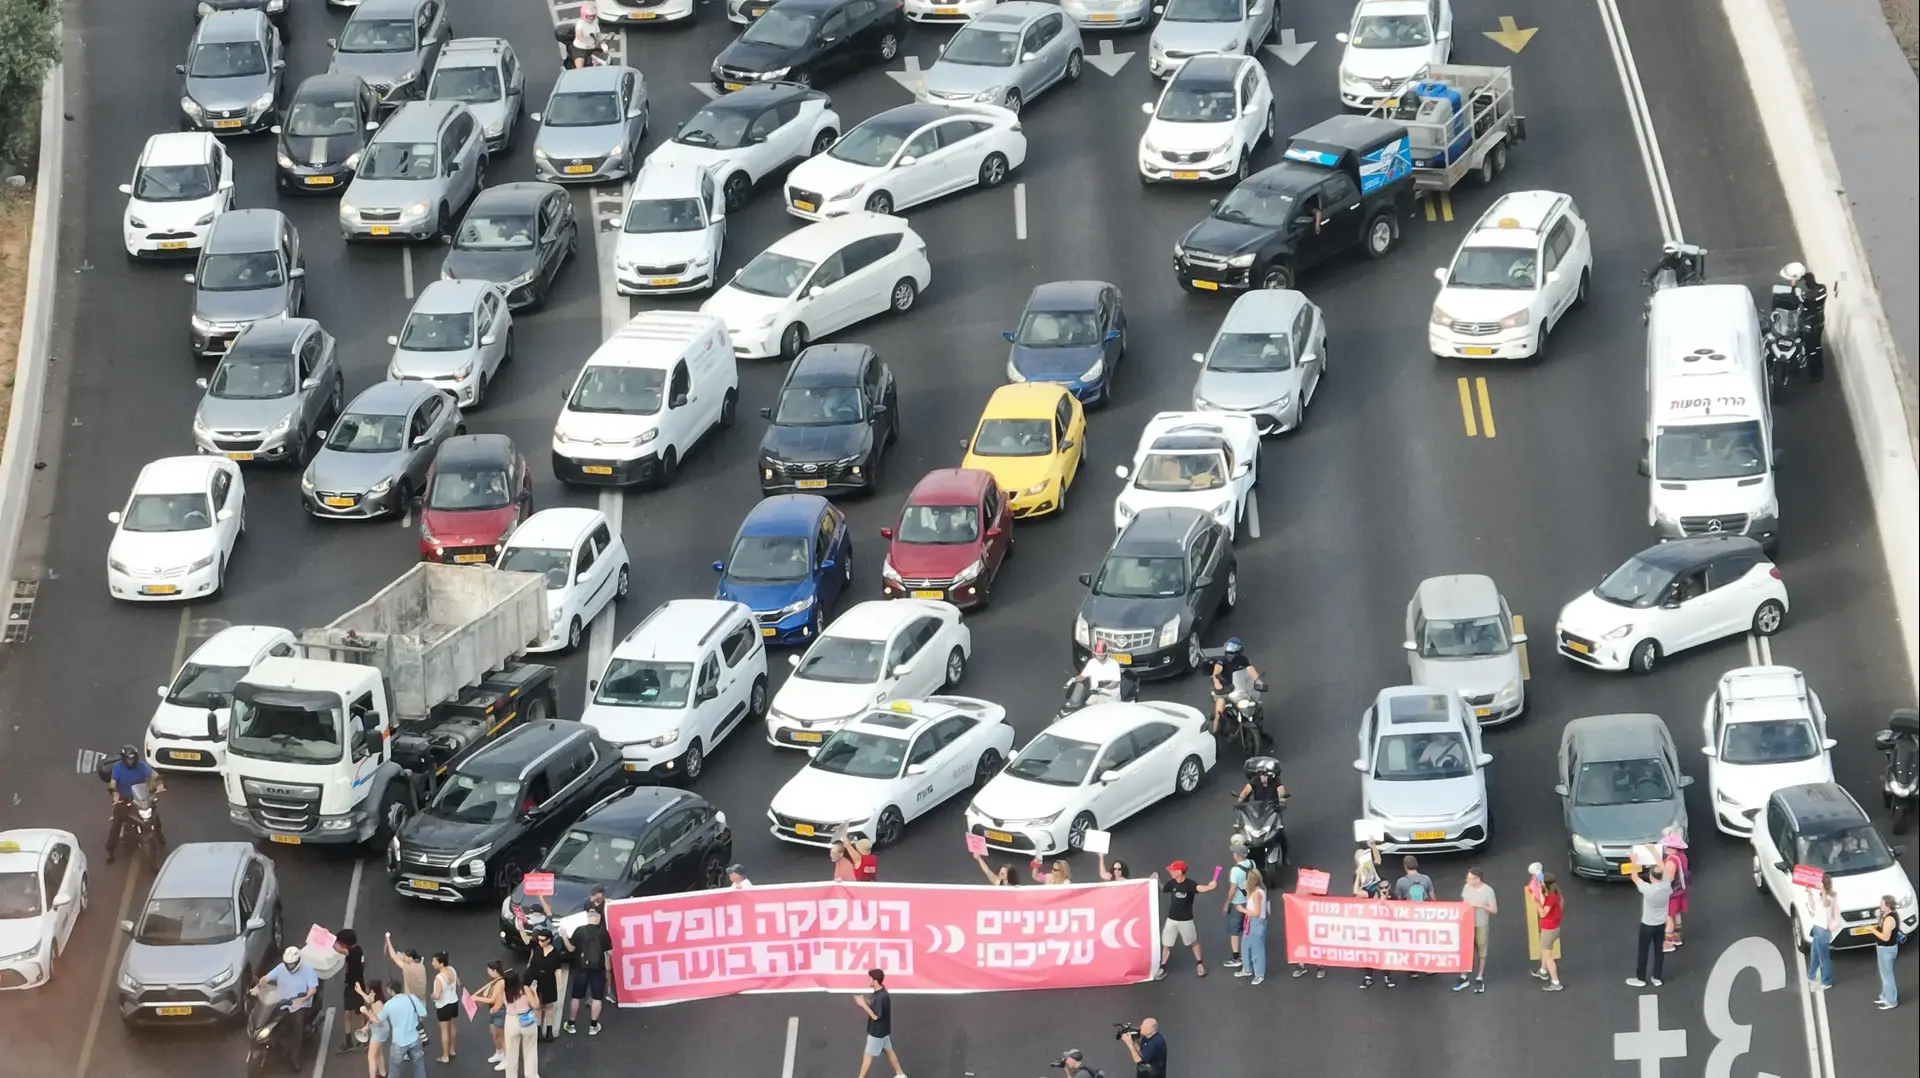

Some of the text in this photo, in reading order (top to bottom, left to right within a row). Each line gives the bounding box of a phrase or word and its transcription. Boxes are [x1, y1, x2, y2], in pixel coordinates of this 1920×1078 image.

[1669, 398, 1711, 410] הסעות
[266, 787, 294, 795] DAF
[1308, 900, 1340, 914] מוות
[1344, 903, 1364, 917] דין
[1393, 907, 1410, 919] או
[1413, 907, 1460, 920] עסקה
[620, 899, 910, 948] העסקה נופלת
[976, 907, 1095, 935] העיניים
[1314, 923, 1454, 945] בוחרות בחיים
[976, 938, 1095, 968] עליכם!
[1309, 946, 1460, 967] הצילו את החטופים
[629, 941, 907, 986] המדינה בוערת
